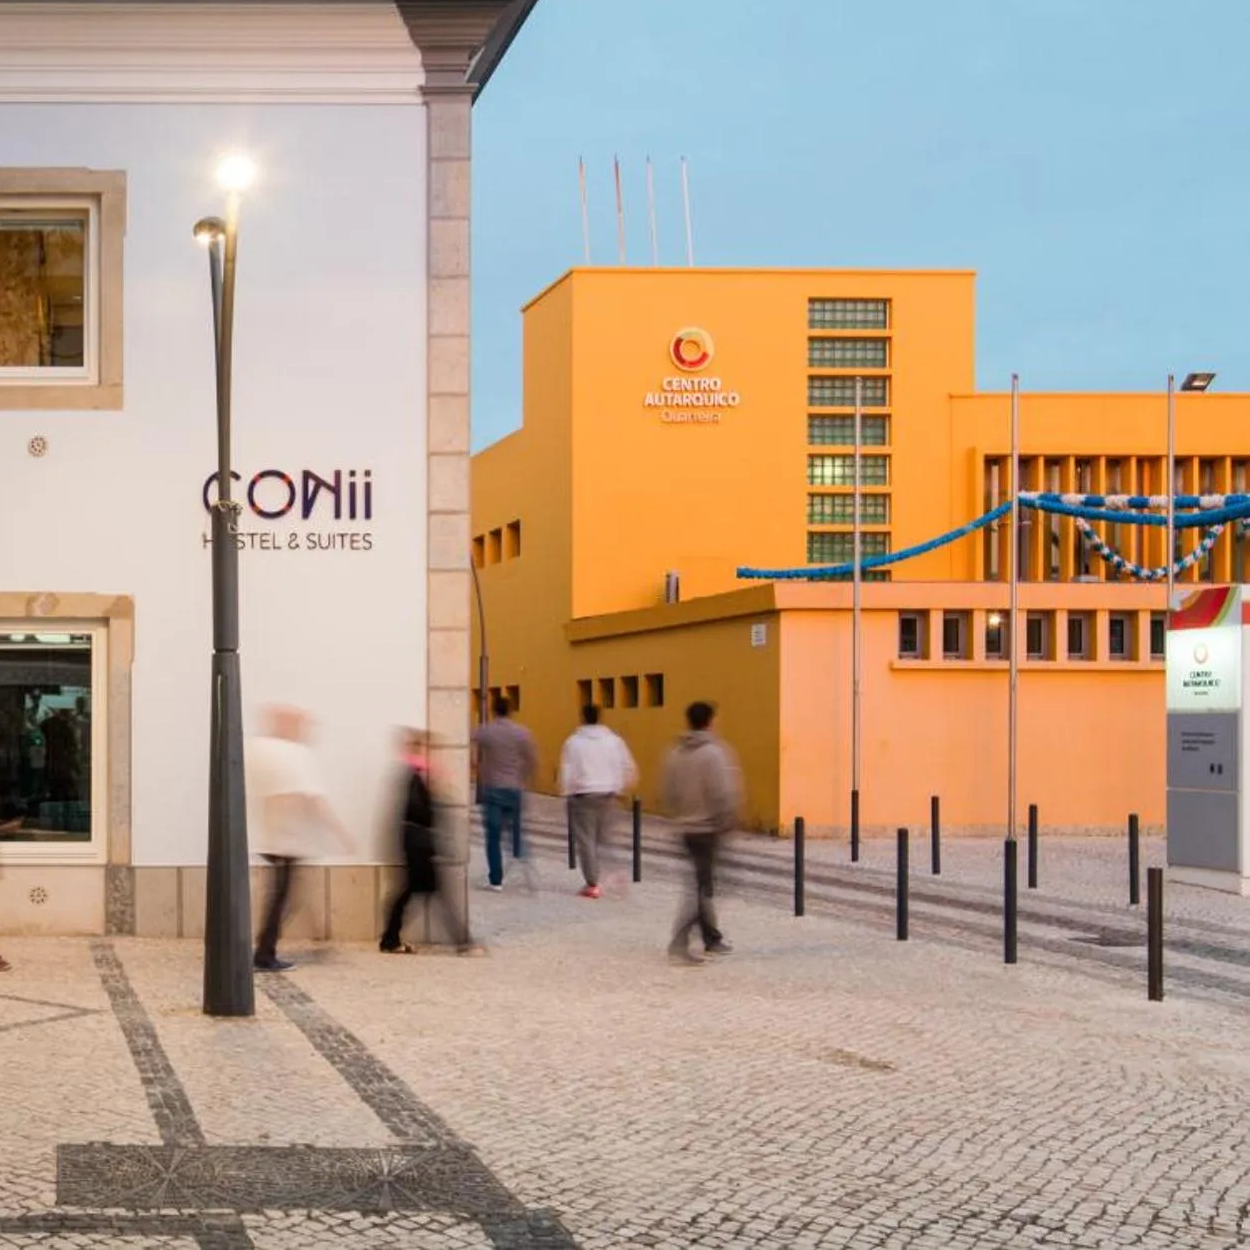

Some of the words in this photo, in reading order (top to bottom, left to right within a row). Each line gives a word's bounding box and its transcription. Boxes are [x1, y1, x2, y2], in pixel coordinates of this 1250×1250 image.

[662, 377, 722, 391] CENTRO
[202, 532, 282, 550] HSTEL
[287, 532, 300, 550] &
[306, 532, 373, 550] SUITES
